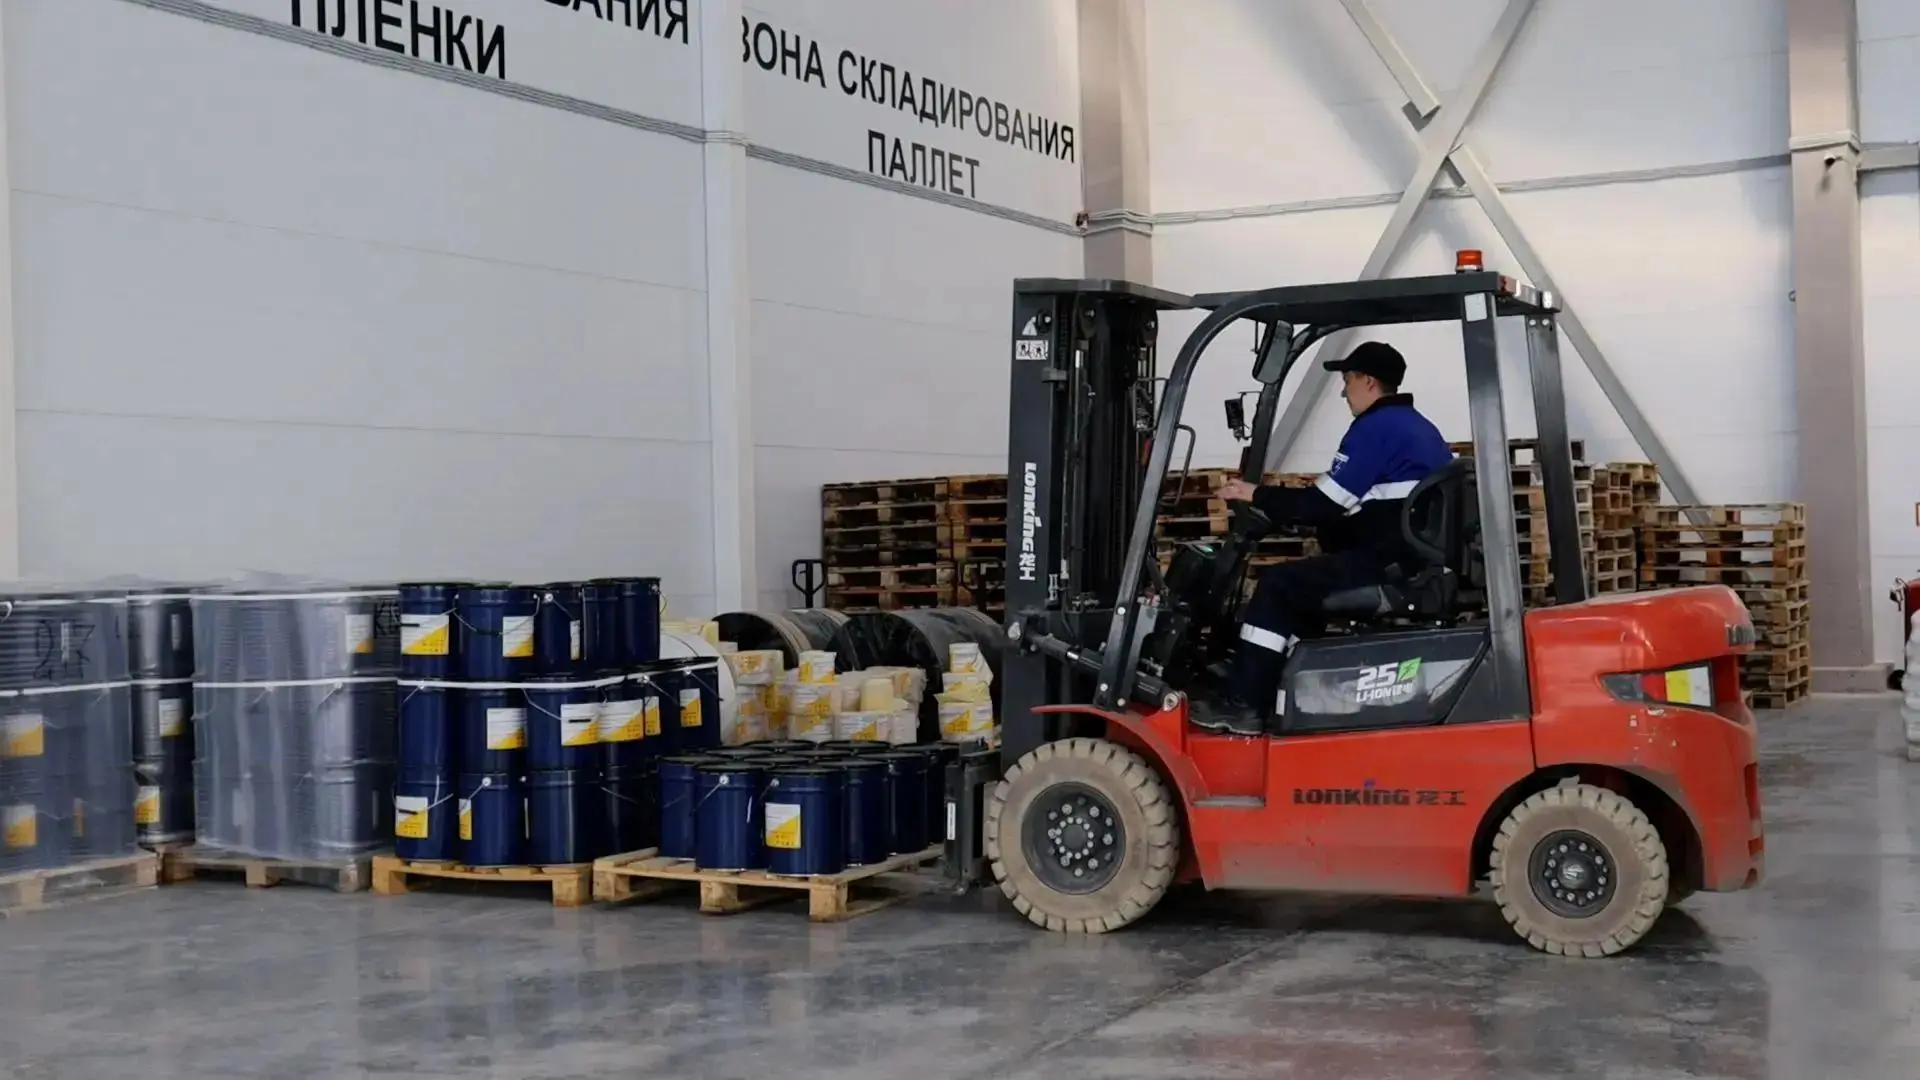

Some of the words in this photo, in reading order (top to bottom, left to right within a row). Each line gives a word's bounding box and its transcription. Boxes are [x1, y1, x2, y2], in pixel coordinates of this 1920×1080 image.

[838, 50, 1075, 164] СКЛАДИРОВАНИЯ
[868, 129, 980, 198] ПАЛЛЕТ
[1357, 662, 1399, 691] 25
